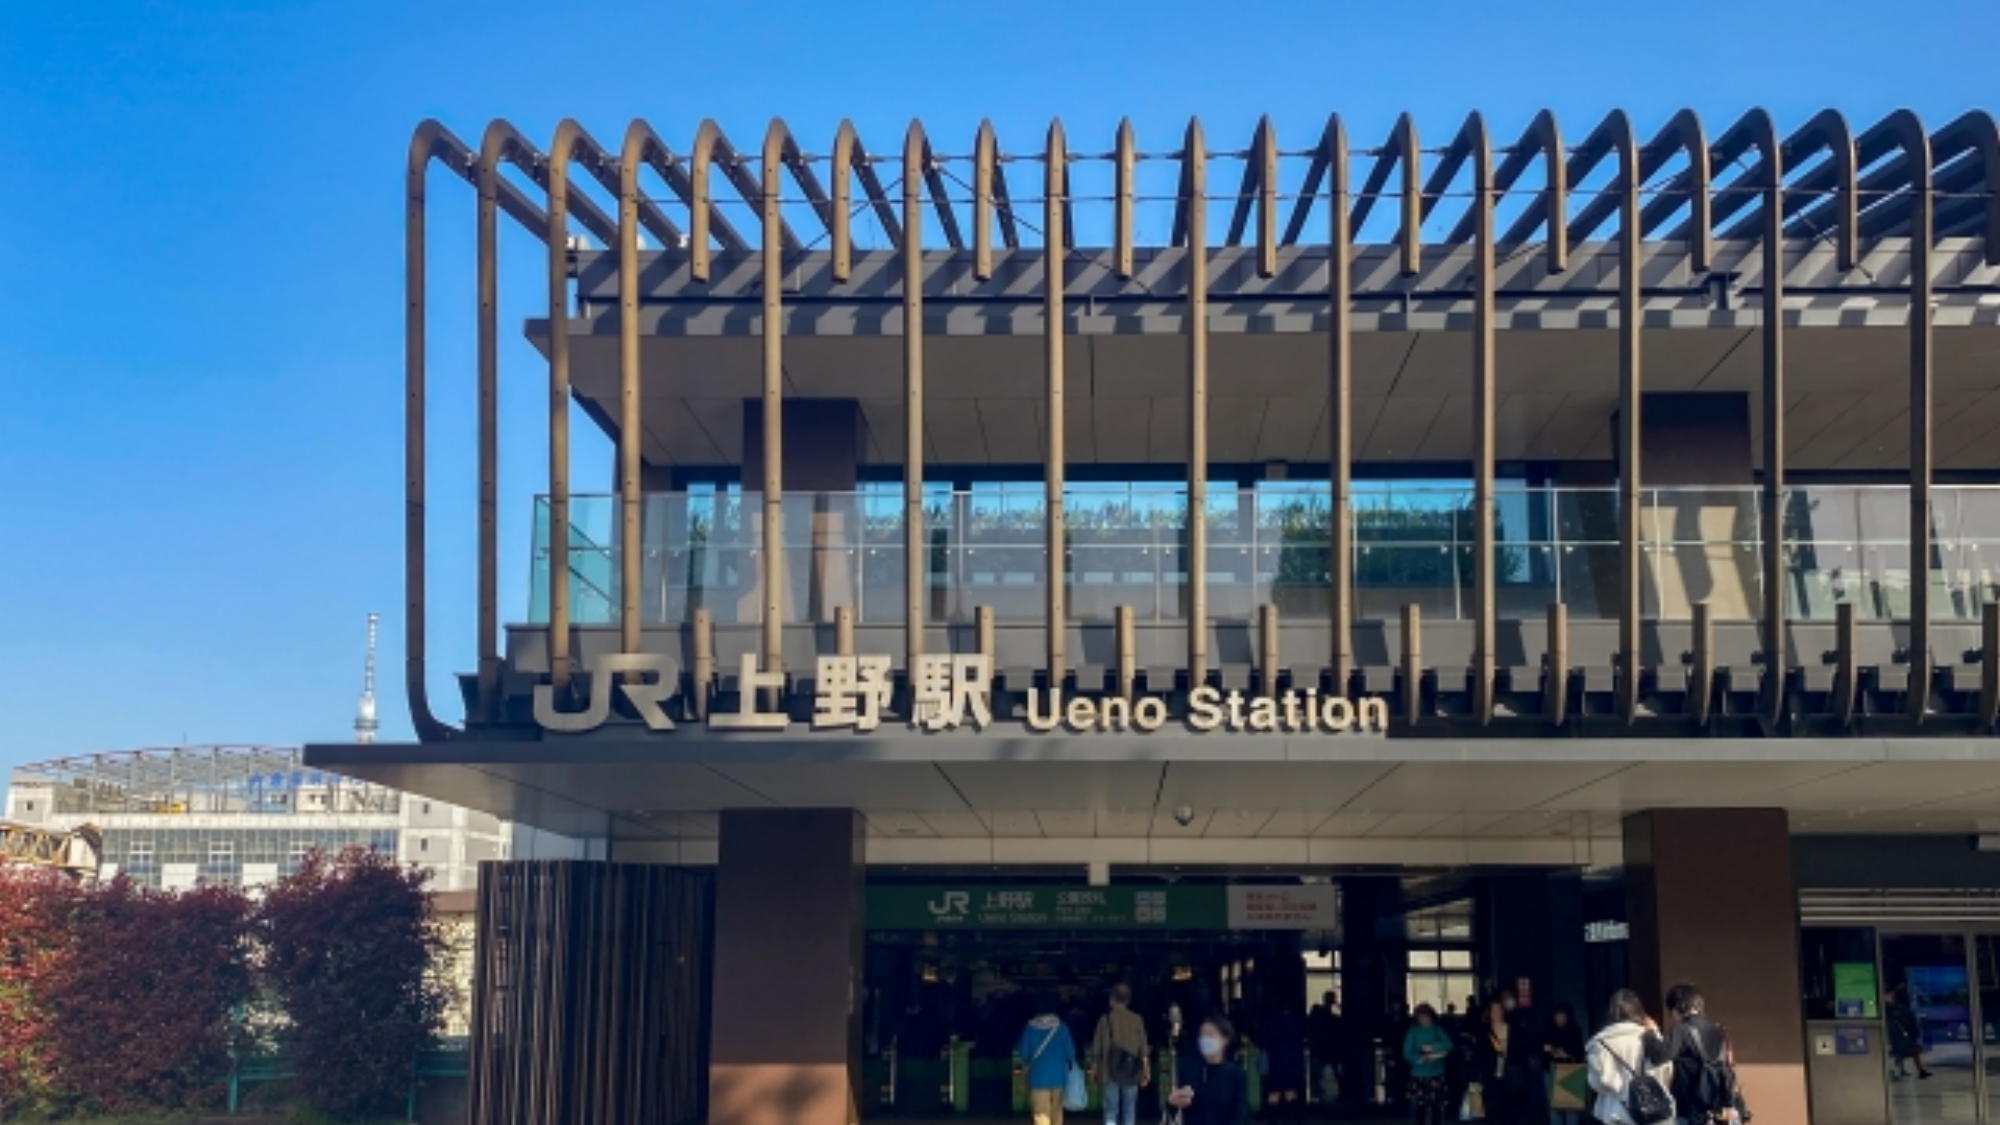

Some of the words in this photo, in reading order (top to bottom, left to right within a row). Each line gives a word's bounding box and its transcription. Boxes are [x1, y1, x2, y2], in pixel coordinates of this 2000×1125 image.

[533, 653, 679, 730] JR
[708, 653, 993, 730] 上野駅
[1027, 687, 1167, 730] Ueno
[1189, 686, 1388, 730] Station
[928, 891, 969, 914] JR
[981, 891, 1034, 911] 上野駅
